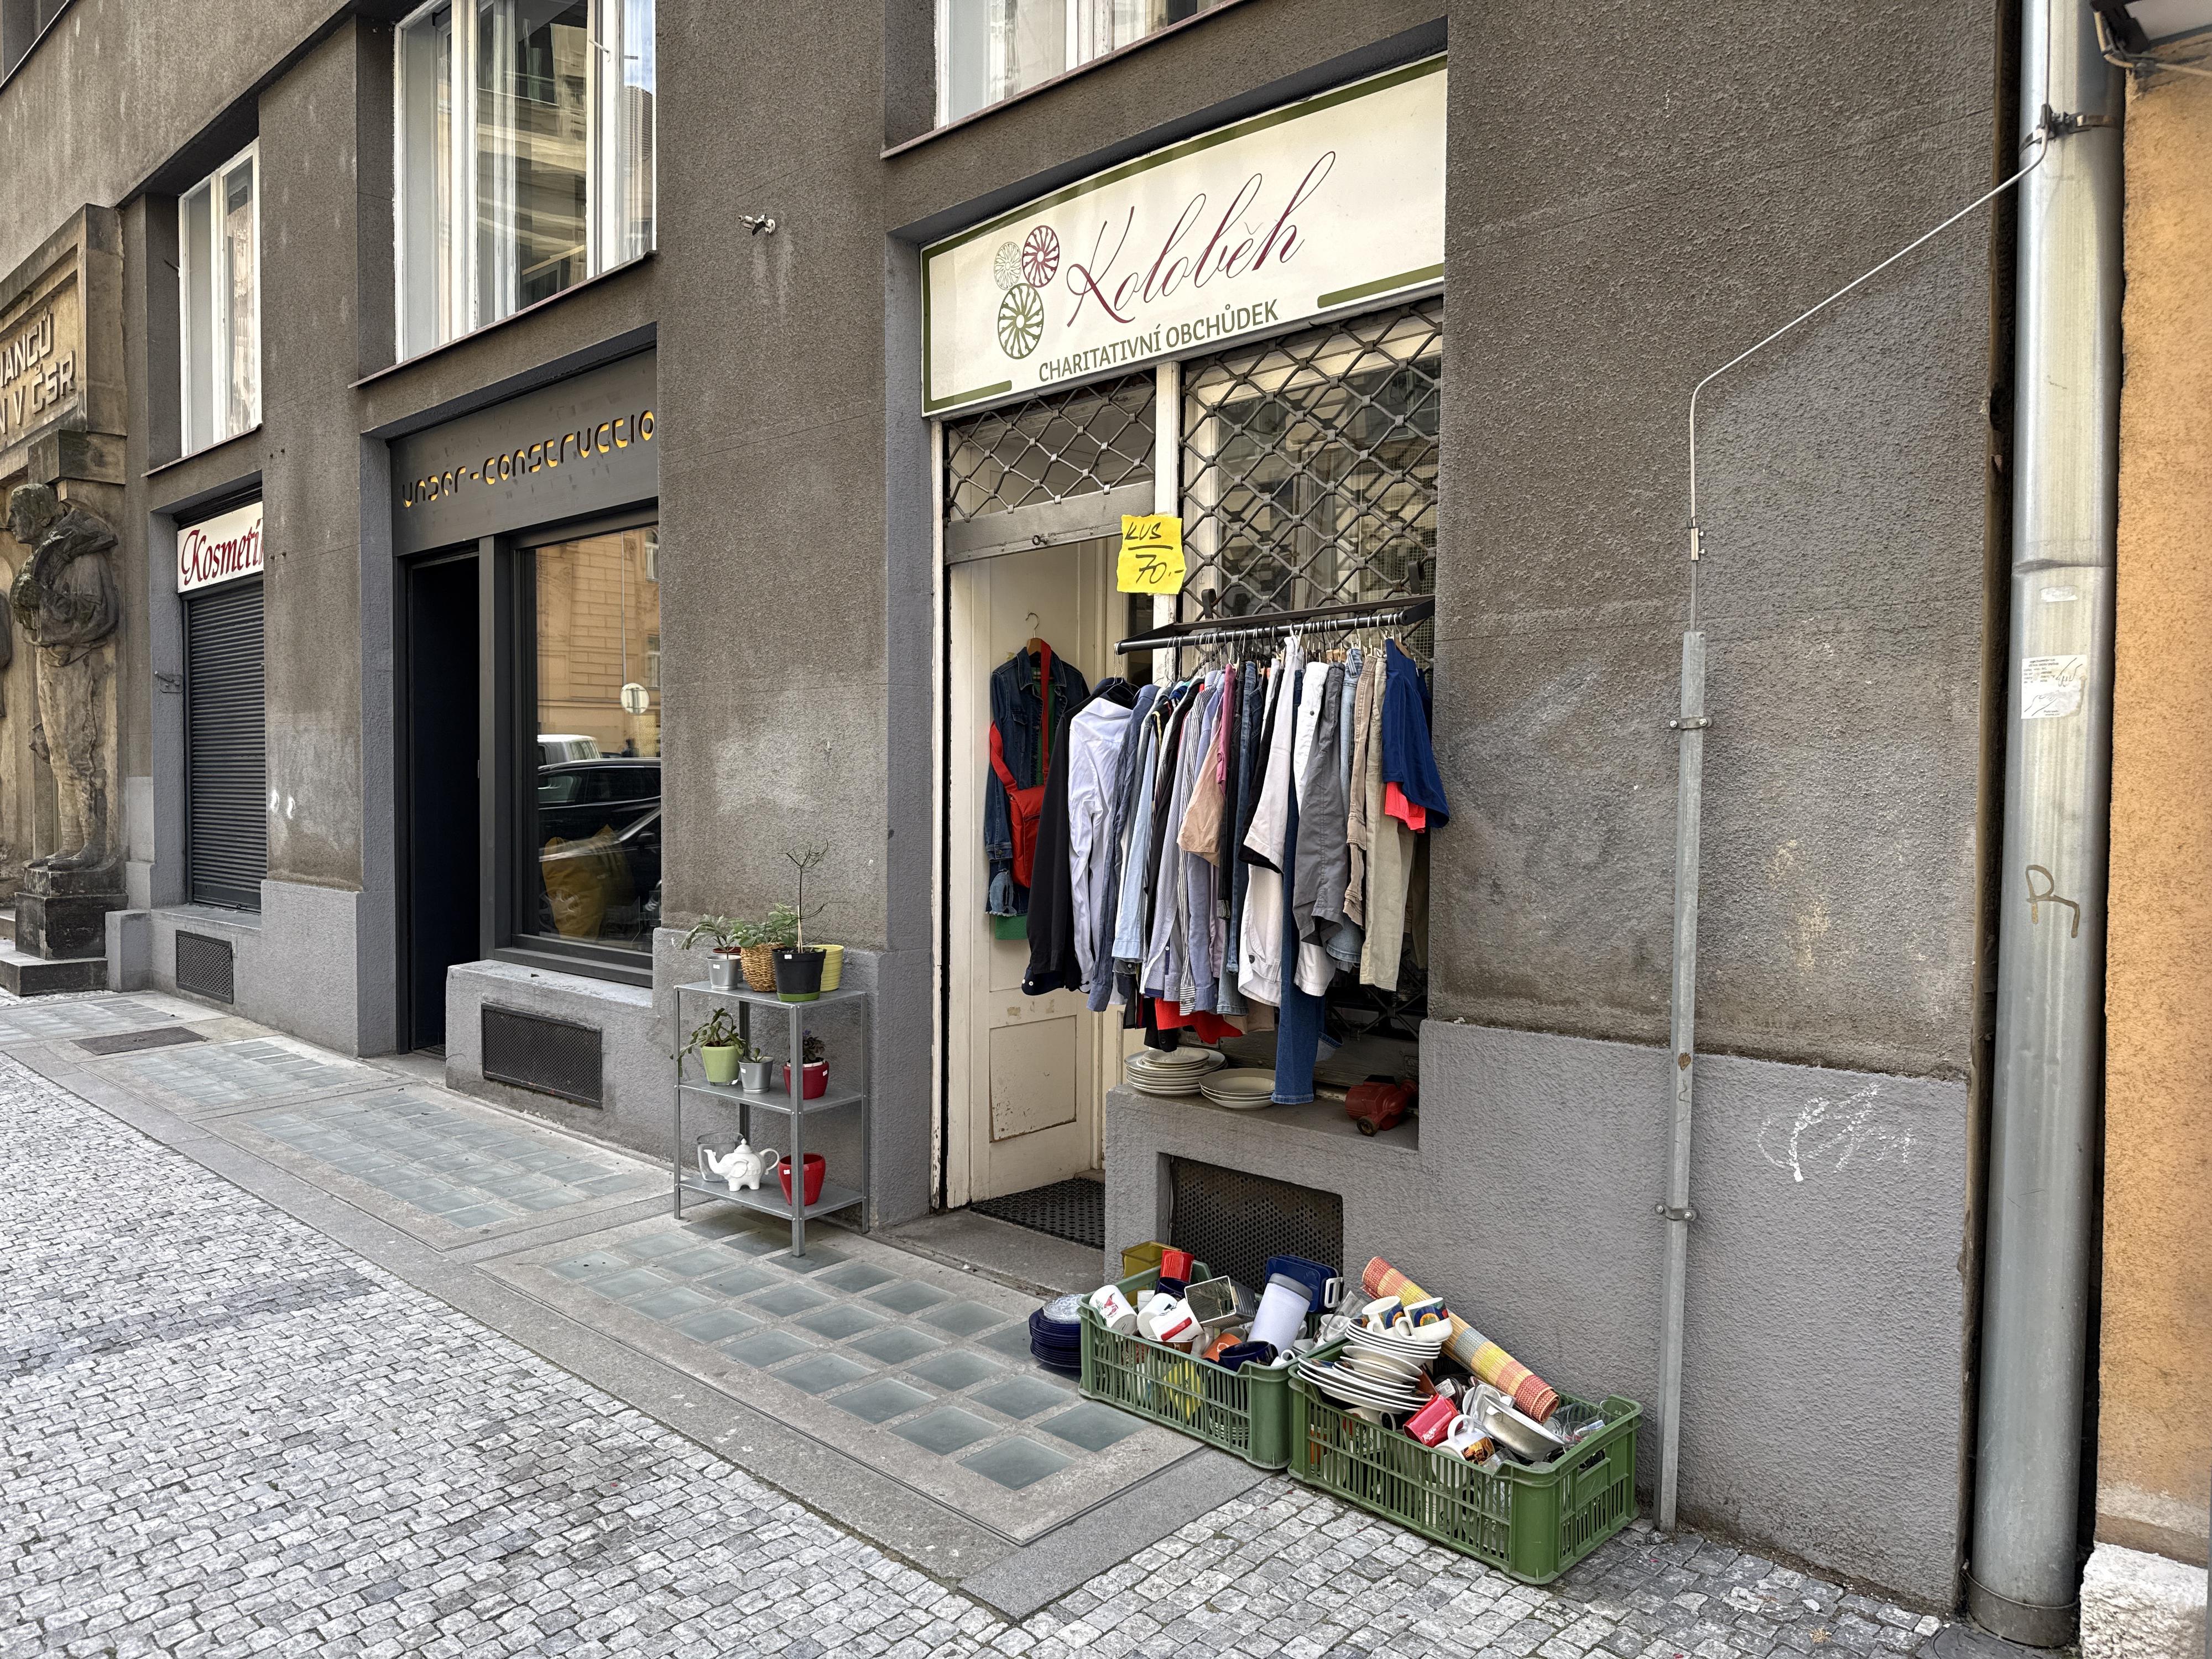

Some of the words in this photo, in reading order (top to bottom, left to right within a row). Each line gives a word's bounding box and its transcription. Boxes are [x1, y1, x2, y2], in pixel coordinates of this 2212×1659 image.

[1067, 151, 1336, 327] Koloběh
[1039, 324, 1161, 382] CHARITATIVNÍ
[1166, 299, 1279, 348] OBCHŮDEK
[13, 385, 25, 425] V
[32, 349, 75, 414] ČSR
[1124, 521, 1162, 541] KUS
